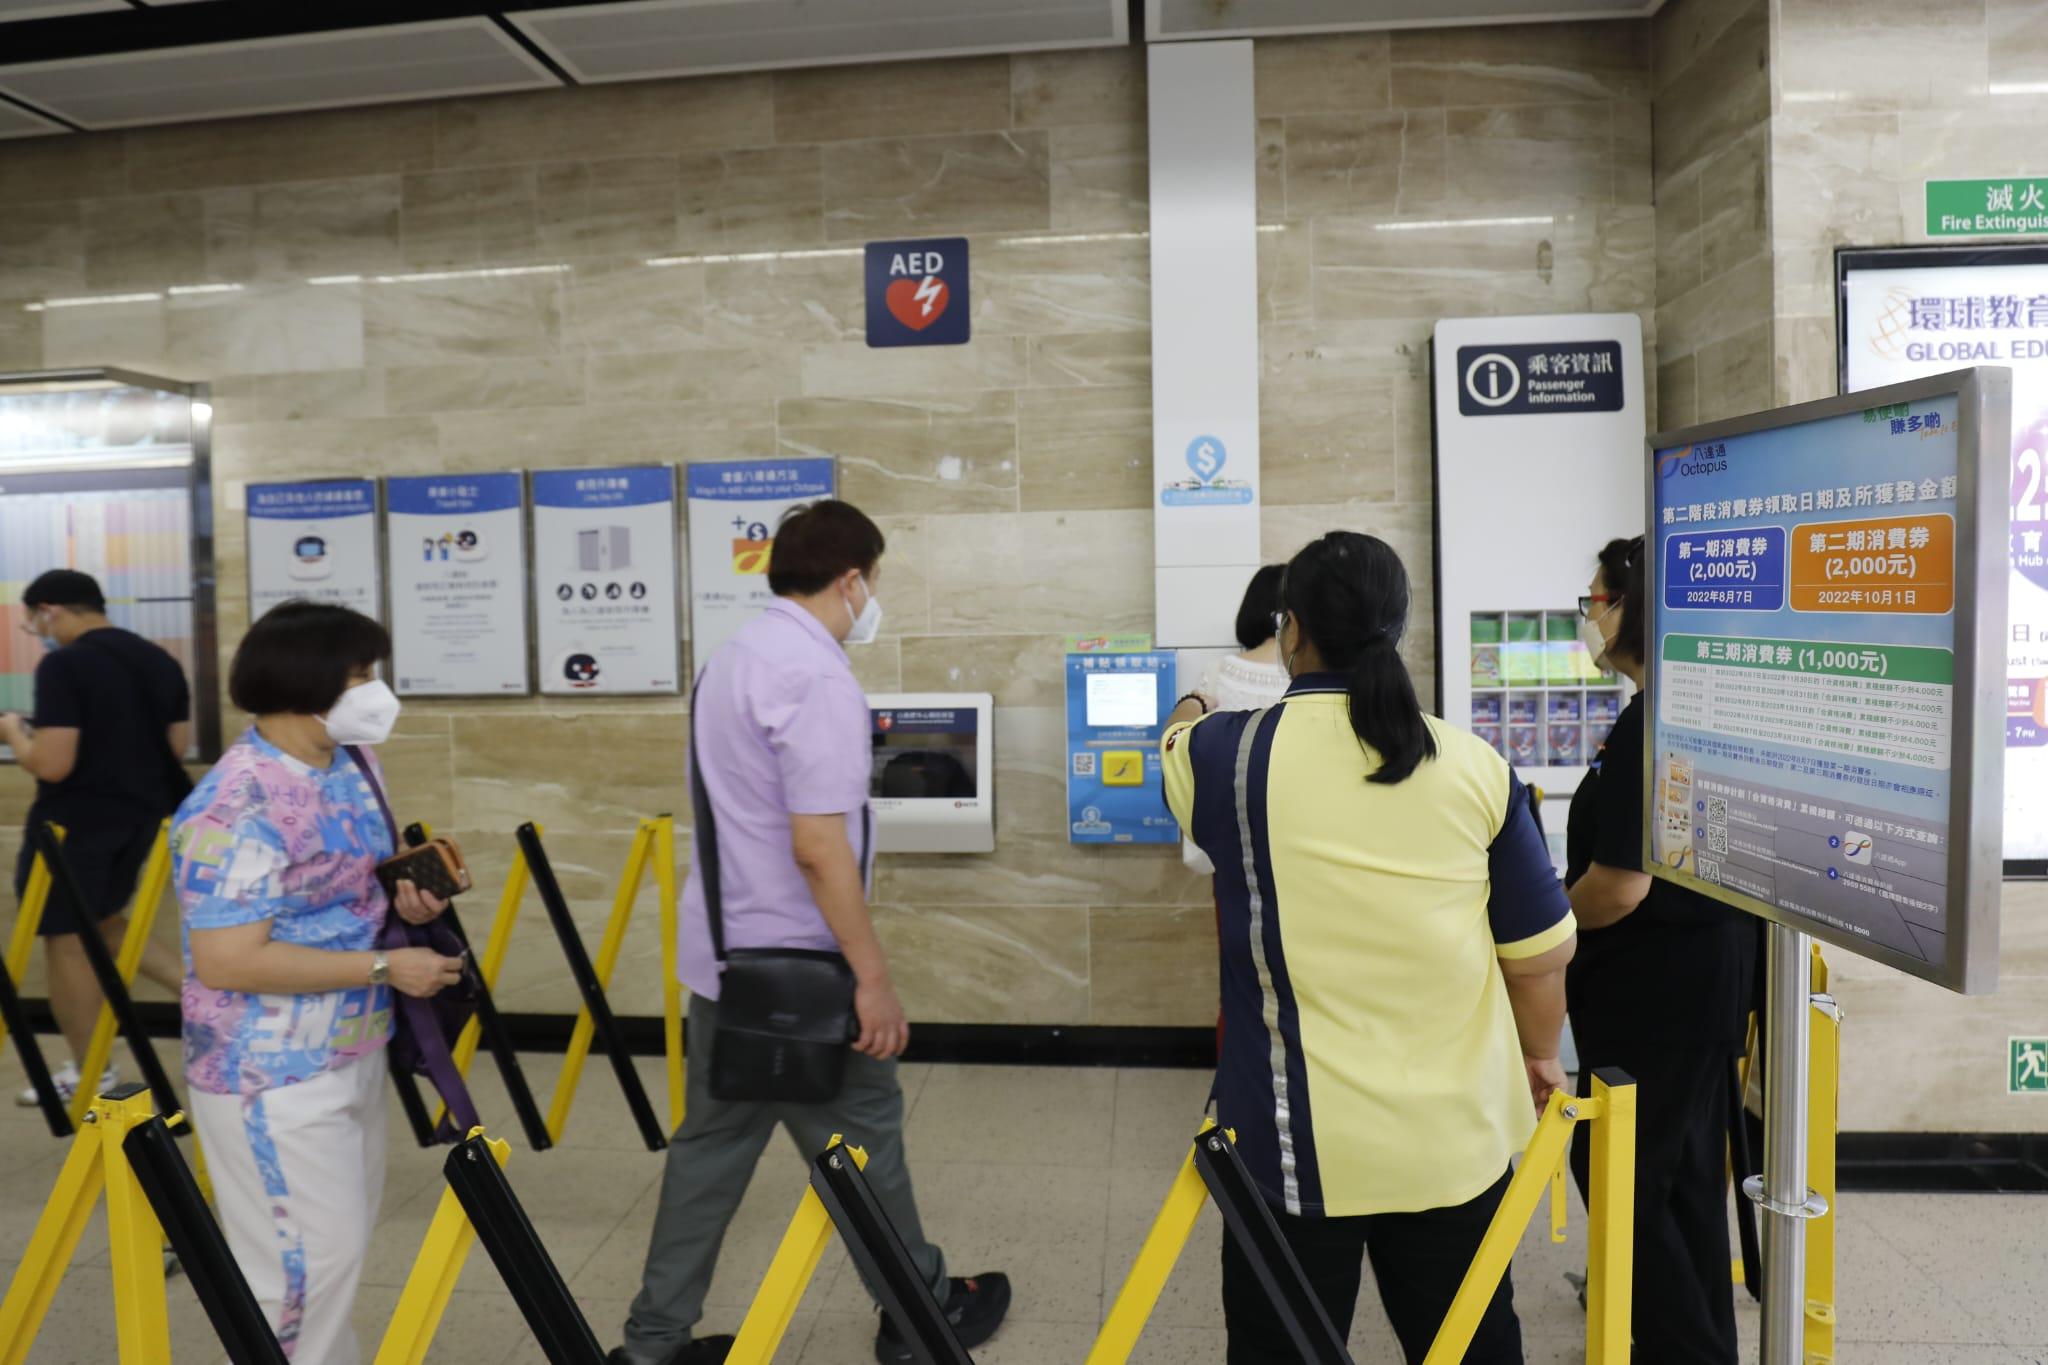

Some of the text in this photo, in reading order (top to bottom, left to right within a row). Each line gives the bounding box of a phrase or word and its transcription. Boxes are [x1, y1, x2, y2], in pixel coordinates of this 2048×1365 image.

[1942, 215, 1972, 231] Fire
[889, 252, 944, 275] AED
[1908, 294, 2048, 331] 環球教育
[1906, 340, 2048, 362] GLOBAL ED
[1528, 351, 1613, 375] 乘客資訊
[1528, 378, 1585, 392] Passenger
[1528, 391, 1596, 404] information
[1693, 443, 1727, 462] 八達通
[1681, 459, 1728, 477] Octopus
[1678, 537, 1768, 559] 第一期消費券
[1809, 526, 1930, 553] 第二期消費券
[1689, 559, 1757, 583] (2,000元)
[1825, 554, 1917, 580] (2,000元)
[1687, 590, 1752, 604] 2022年8月7日
[1818, 590, 1916, 605] 2022年10月1日
[1697, 640, 1888, 676] 第三期消費券 (1,000元)
